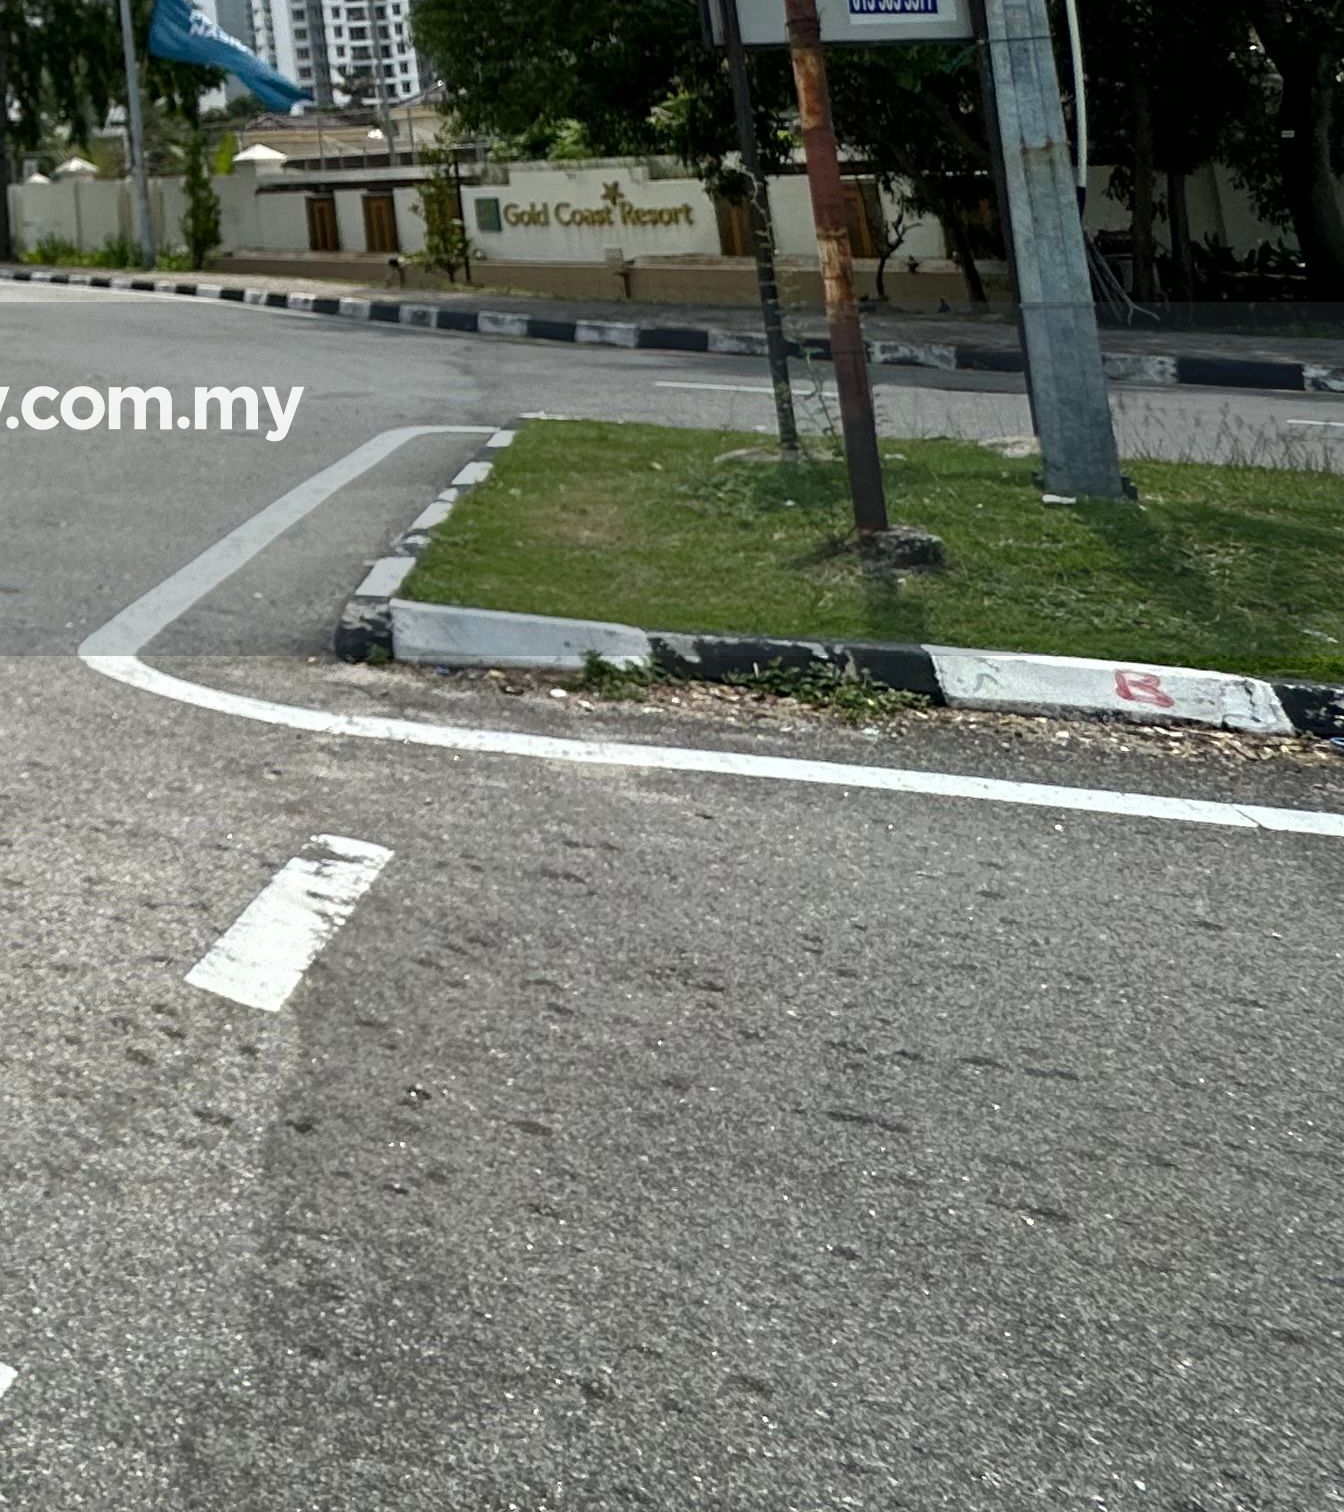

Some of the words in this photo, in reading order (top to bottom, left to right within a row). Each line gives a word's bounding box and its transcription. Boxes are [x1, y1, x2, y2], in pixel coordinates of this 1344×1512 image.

[504, 201, 550, 227] Gold
[555, 202, 614, 227] Coast
[620, 200, 694, 226] Resort
